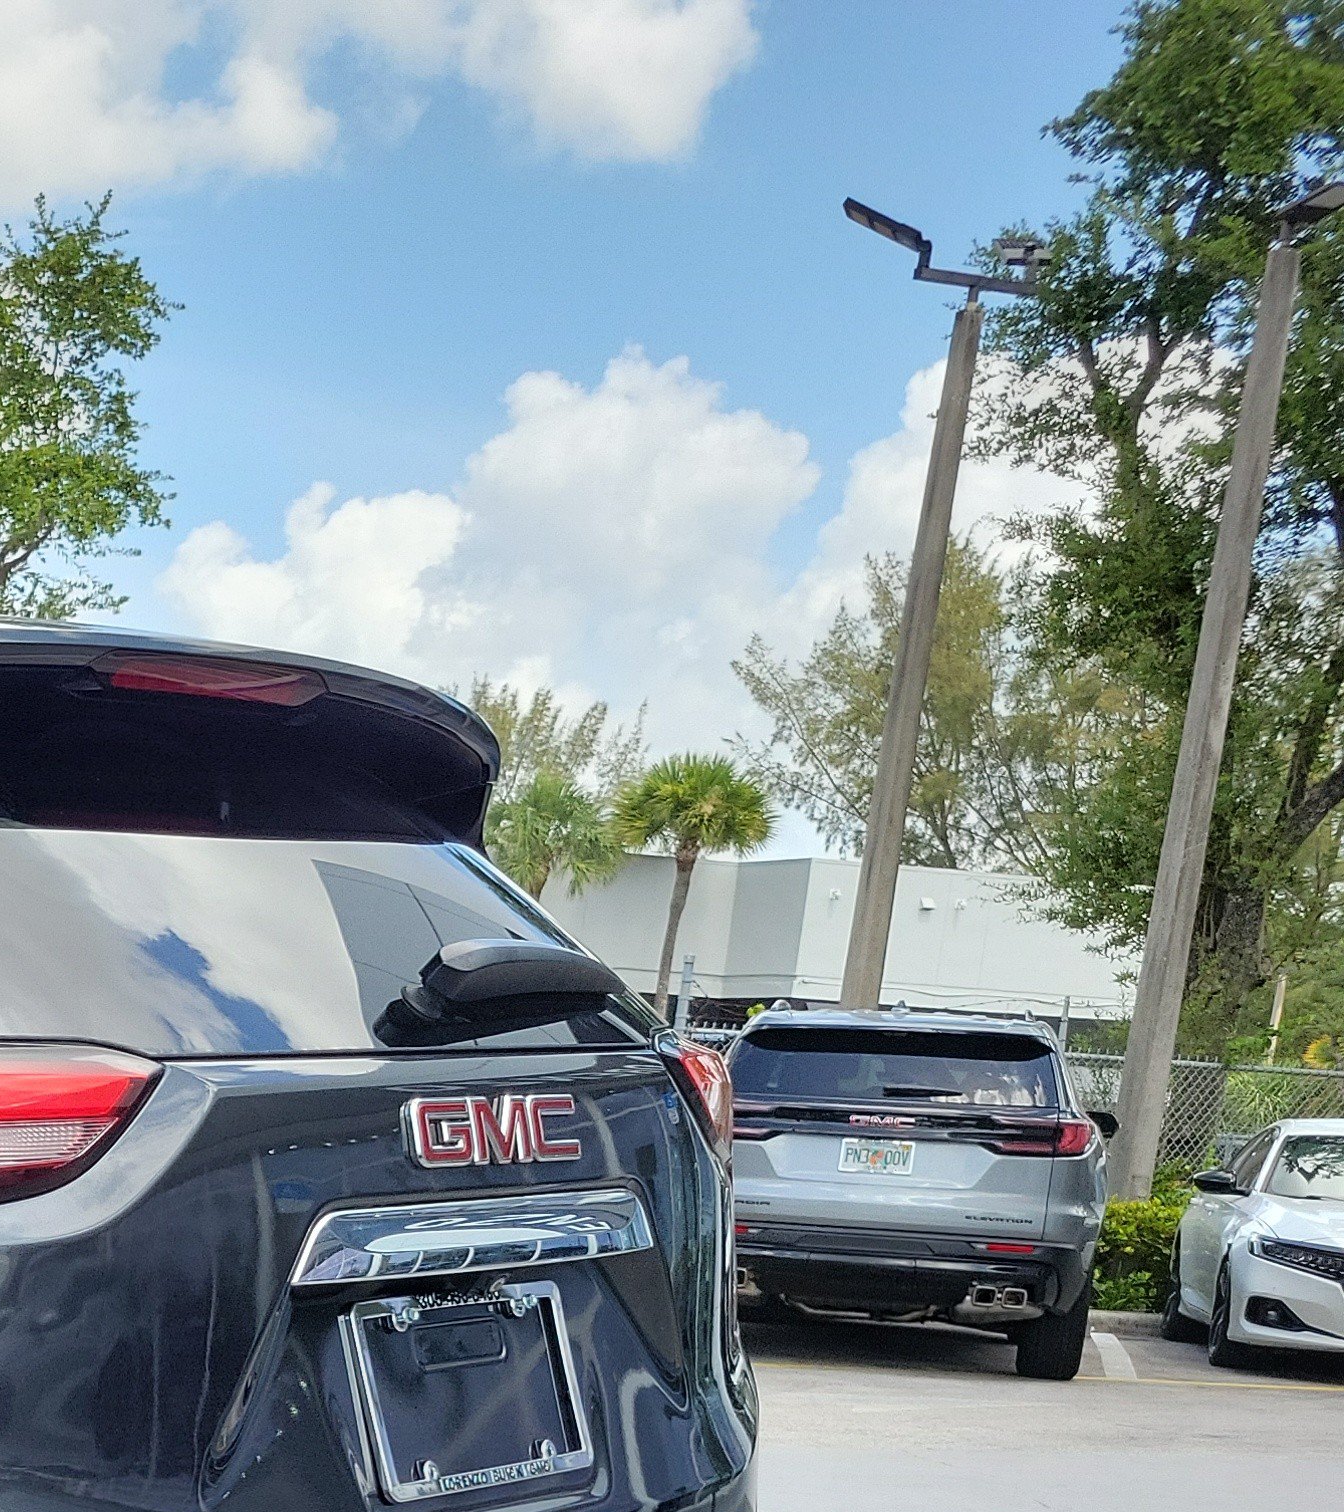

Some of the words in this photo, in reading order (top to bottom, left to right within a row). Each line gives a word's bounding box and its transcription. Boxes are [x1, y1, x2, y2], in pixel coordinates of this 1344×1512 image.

[405, 1093, 583, 1169] GMC
[849, 1114, 916, 1130] GMC
[441, 1473, 488, 1492] LORENZO
[493, 1465, 525, 1483] BUICK
